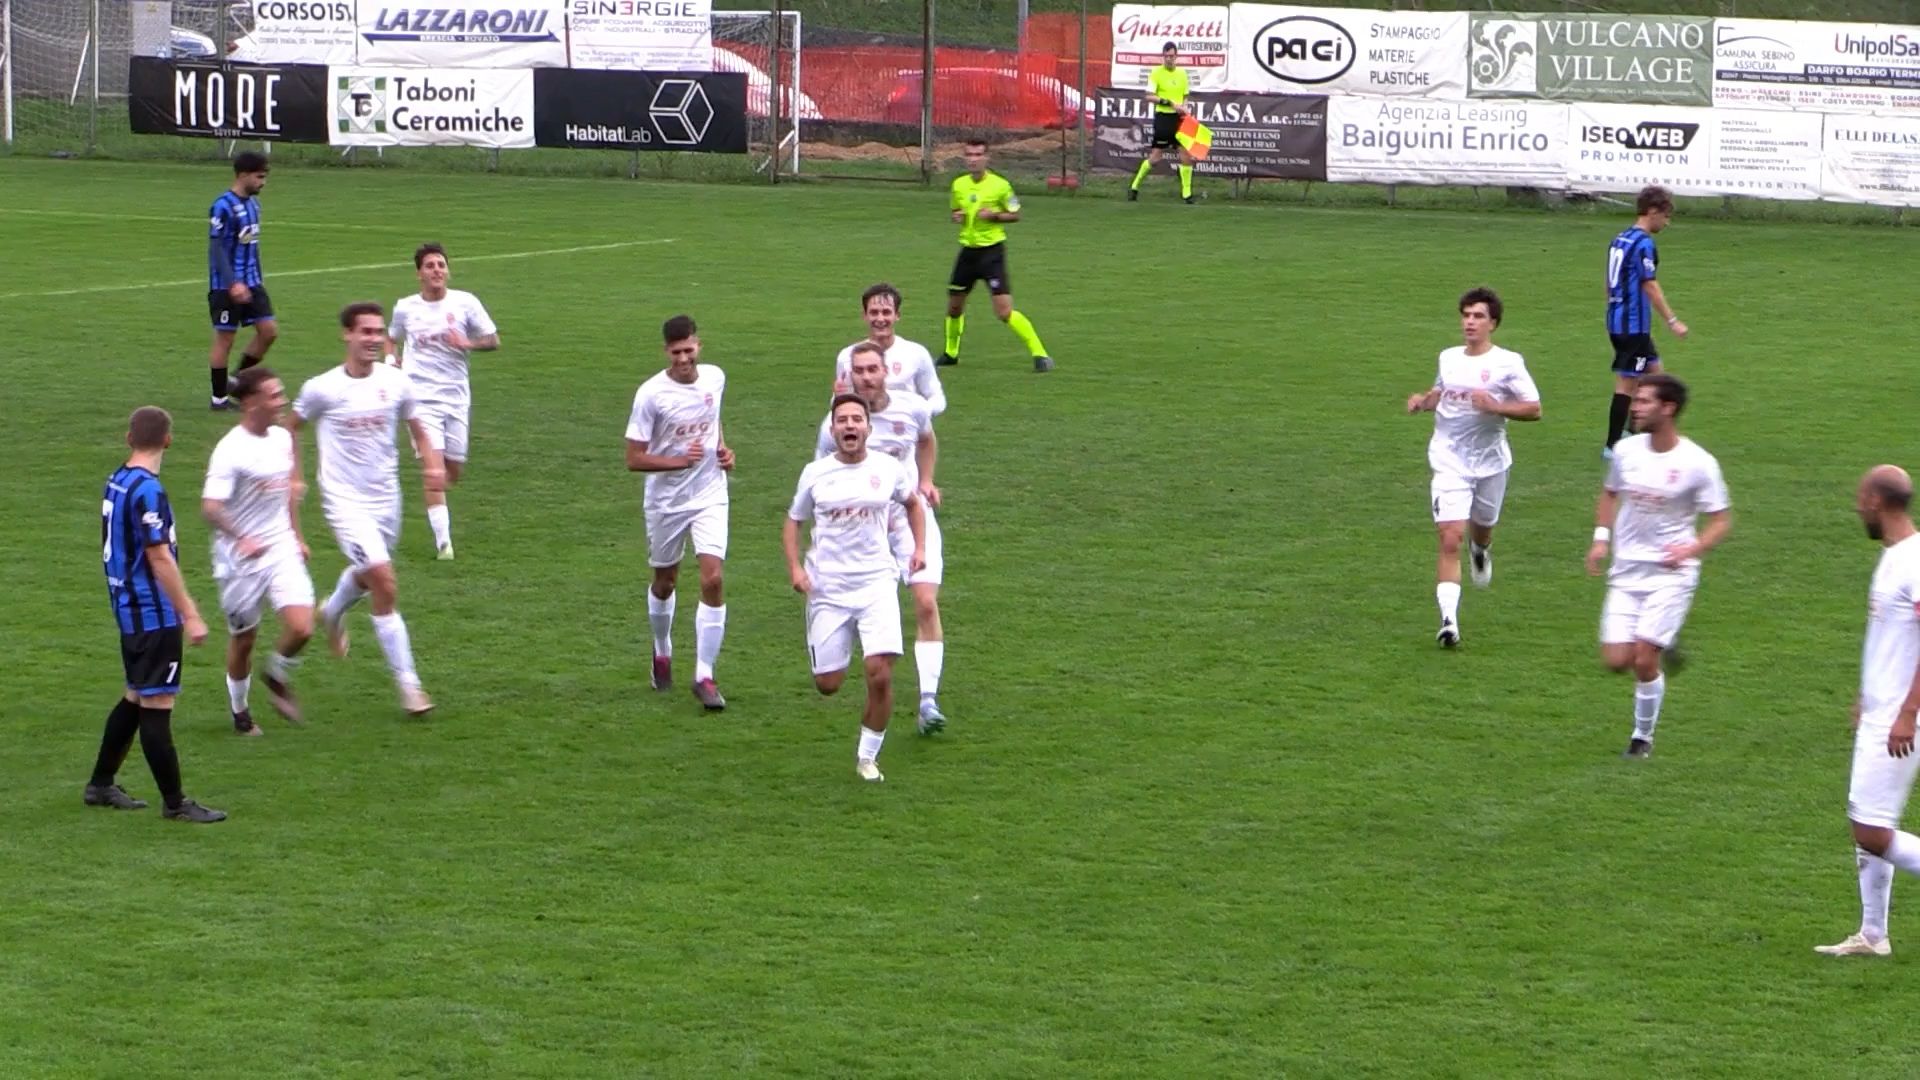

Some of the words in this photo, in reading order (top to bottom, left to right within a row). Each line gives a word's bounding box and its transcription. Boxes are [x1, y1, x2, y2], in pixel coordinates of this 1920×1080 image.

[374, 8, 549, 33] LAZZARONI
[1118, 14, 1223, 42] Guizzetti
[1370, 23, 1441, 41] STAMPAGGIO
[464, 35, 500, 43] ROVATO
[1541, 20, 1704, 49] VULCANO
[1368, 49, 1415, 64] MATERIE
[1716, 48, 1757, 59] CAMUNA
[1762, 50, 1795, 61] SEBINO
[1835, 33, 1919, 61] UnipolSa
[1549, 54, 1695, 83] VILLAGE
[1733, 61, 1777, 71] ASSICURA
[1808, 65, 1844, 76] DARFO
[1846, 67, 1887, 77] BOARIO
[393, 77, 476, 102] Taboni
[1370, 71, 1430, 86] PLASTICHE
[175, 70, 281, 131] MORE
[392, 107, 524, 132] Ceramiche
[1377, 103, 1451, 124] Agenzia
[1457, 104, 1527, 127] Leasing
[566, 124, 651, 143] HabitatLab
[1343, 122, 1453, 155] Baiguini
[1462, 126, 1548, 151] Enrico
[1581, 150, 1688, 164] PROMOTION
[166, 661, 179, 683] 7
